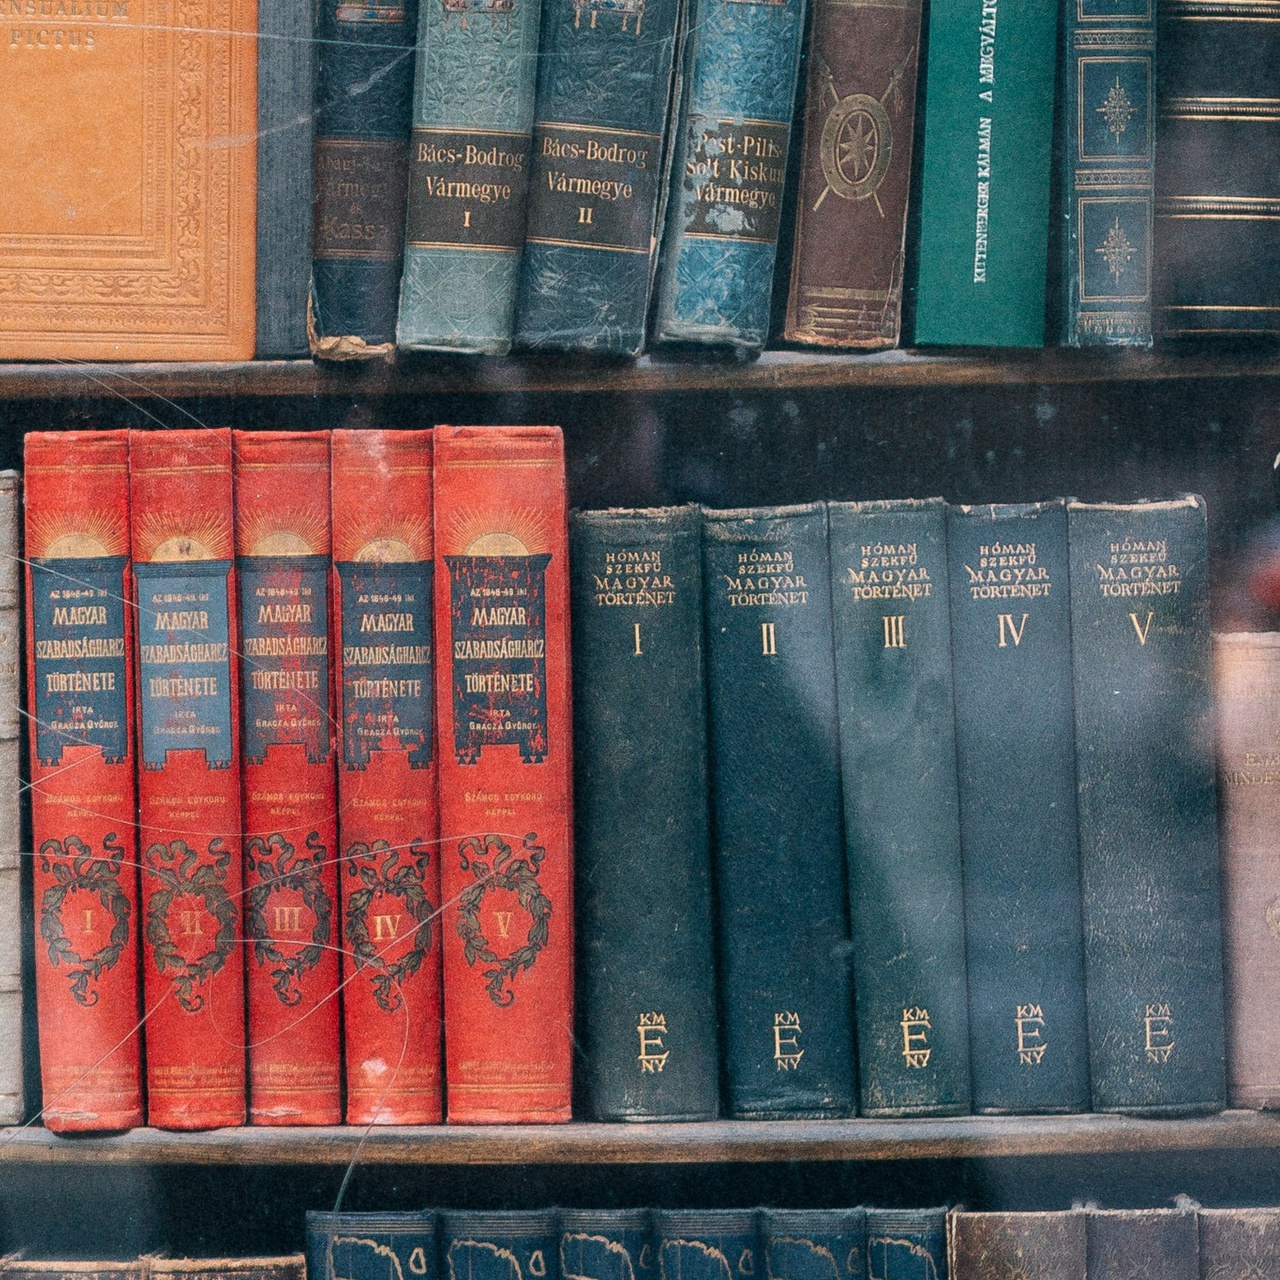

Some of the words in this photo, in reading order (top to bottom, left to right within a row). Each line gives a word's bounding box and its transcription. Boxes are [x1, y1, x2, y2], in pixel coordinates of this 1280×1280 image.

[9, 29, 96, 50] PICTUS
[978, 90, 993, 103] A
[417, 142, 525, 170] Bács-Bodrog
[542, 136, 649, 169] Bács-Bodrog
[976, 117, 992, 178] KÁLMÁN
[426, 176, 511, 204] Vármegye
[546, 170, 633, 202] Vármegye
[463, 211, 471, 228] I
[578, 206, 594, 225] II
[861, 542, 917, 555] HÓMAN
[979, 541, 1036, 556] HÓMAN
[1110, 538, 1166, 553] HÓMAN
[606, 549, 661, 563] HÓMAN
[738, 549, 793, 563] HÓMAN
[592, 573, 675, 591] MAGYAR
[724, 573, 808, 591] MAGYAR
[847, 567, 930, 583] MAGYAR
[963, 564, 1050, 583] MAGYAR
[1096, 563, 1180, 581] MAGYAR
[727, 588, 809, 607] TÖRTÉNET
[851, 581, 933, 602] TÖRTÉNET
[970, 579, 1052, 600] TÖRTÉNET
[1099, 578, 1181, 597] TÖRTÉNET
[594, 588, 676, 608] TÖRTÉNET
[52, 606, 107, 626] MAGYAR
[153, 610, 209, 631] MAGYAR
[257, 604, 312, 624] MAGYAR
[360, 613, 415, 632] MAGYAR
[471, 606, 527, 627] MAGYAR
[634, 622, 643, 655] I
[761, 622, 778, 655] II
[882, 615, 907, 649] III
[997, 613, 1029, 648] IV
[1129, 611, 1154, 646] V
[454, 636, 545, 660] SZABADSÁGHARCZ
[46, 670, 115, 692] TÖRTÉNETE
[352, 676, 421, 698] TÖRTÉNETE
[464, 671, 535, 693] TÖRTÉNETE
[81, 908, 93, 934] I
[181, 909, 203, 935] II
[273, 906, 305, 933] III
[373, 913, 401, 941] IV
[495, 911, 512, 937] V
[639, 1010, 667, 1025] KM
[774, 1010, 801, 1025] KM
[902, 1006, 931, 1021] KM
[1016, 1003, 1044, 1017] KM
[1145, 1002, 1171, 1017] KM
[641, 1059, 667, 1073] NY
[777, 1058, 802, 1071] NY
[905, 1054, 931, 1068] NY
[1019, 1050, 1045, 1065] NY
[1147, 1049, 1171, 1064] NY
